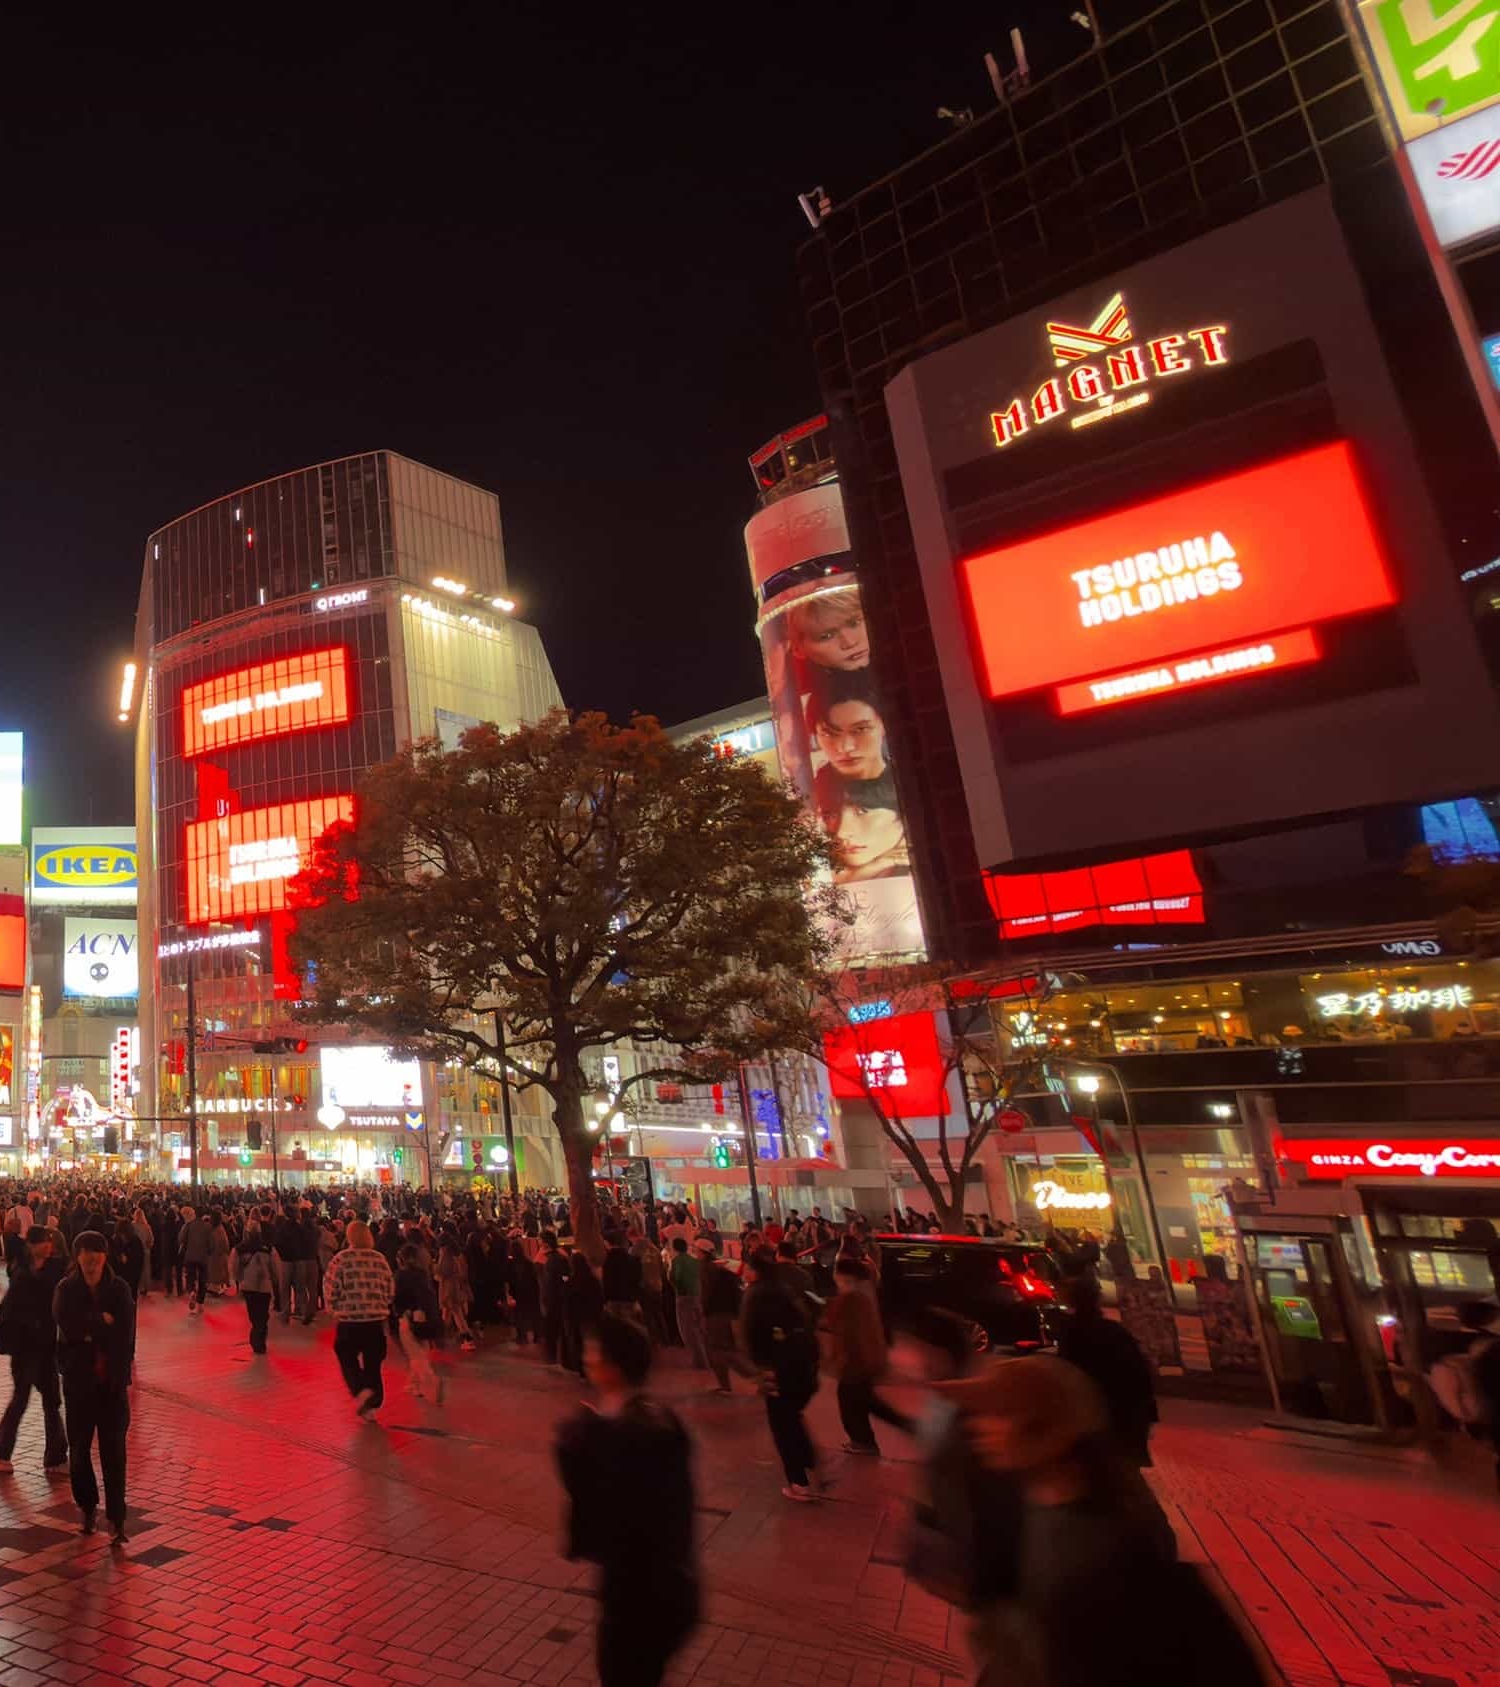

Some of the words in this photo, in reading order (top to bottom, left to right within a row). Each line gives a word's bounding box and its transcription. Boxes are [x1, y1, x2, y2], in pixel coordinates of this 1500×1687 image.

[991, 326, 1227, 446] MAGNET
[1071, 531, 1236, 599] TSURUHA
[1078, 561, 1243, 627] HOLDINGS
[46, 858, 136, 874] IKEA
[67, 933, 138, 955] ACN
[350, 1116, 400, 1125] TSUTAYA
[1311, 1155, 1364, 1165] GINZA
